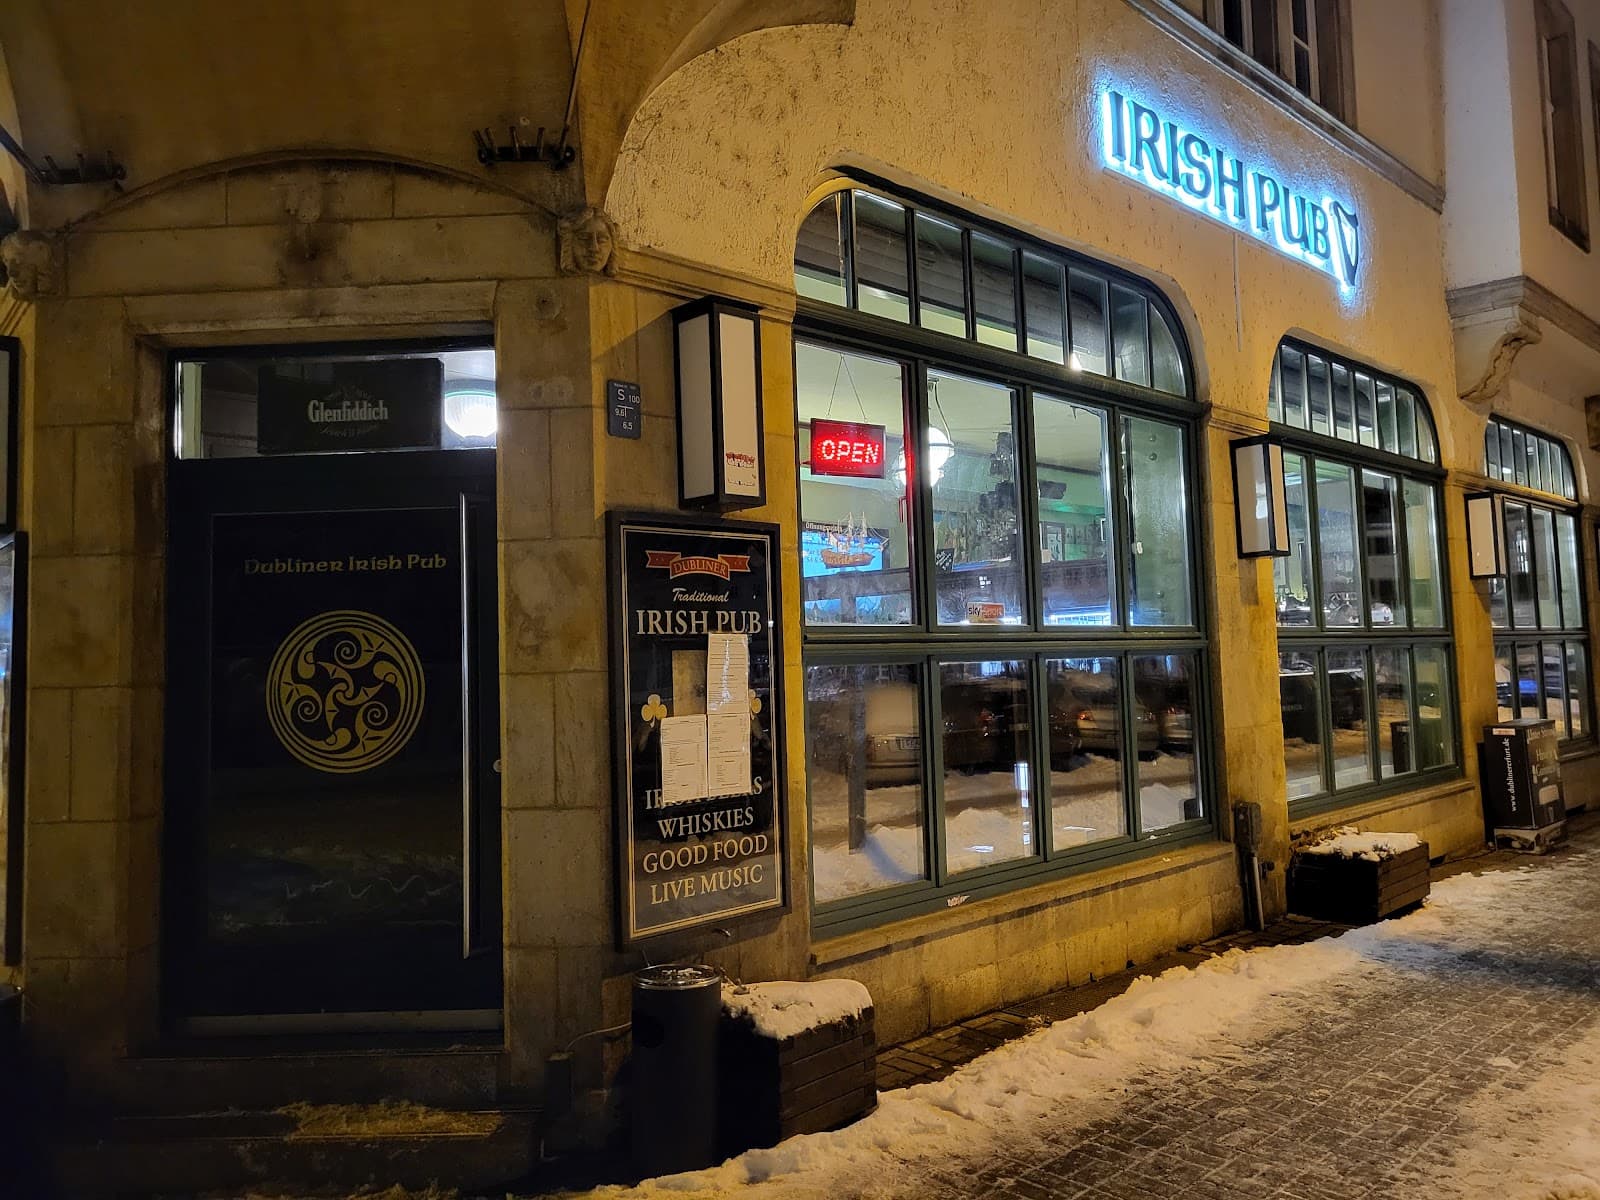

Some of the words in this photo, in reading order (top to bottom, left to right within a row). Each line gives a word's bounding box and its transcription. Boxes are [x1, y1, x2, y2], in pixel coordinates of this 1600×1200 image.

[1108, 91, 1246, 219] IRISH
[1252, 171, 1331, 259] PUB
[617, 388, 626, 401] S
[629, 394, 641, 404] 100
[308, 399, 389, 423] Glenfiddich
[821, 439, 880, 464] OPEN
[244, 558, 344, 575] Dubliner
[349, 554, 402, 572] Irish
[407, 553, 447, 570] Pub
[673, 559, 727, 577] DUBLINER
[672, 587, 731, 603] Traditional
[636, 609, 709, 635] IRISH
[715, 610, 762, 635] PUB
[968, 603, 981, 617] sky
[657, 806, 755, 839] WHISKIES
[643, 843, 708, 874] GOOD
[713, 834, 768, 861] FOOD
[650, 877, 696, 905] LIVE
[701, 864, 763, 895] MUSIC
